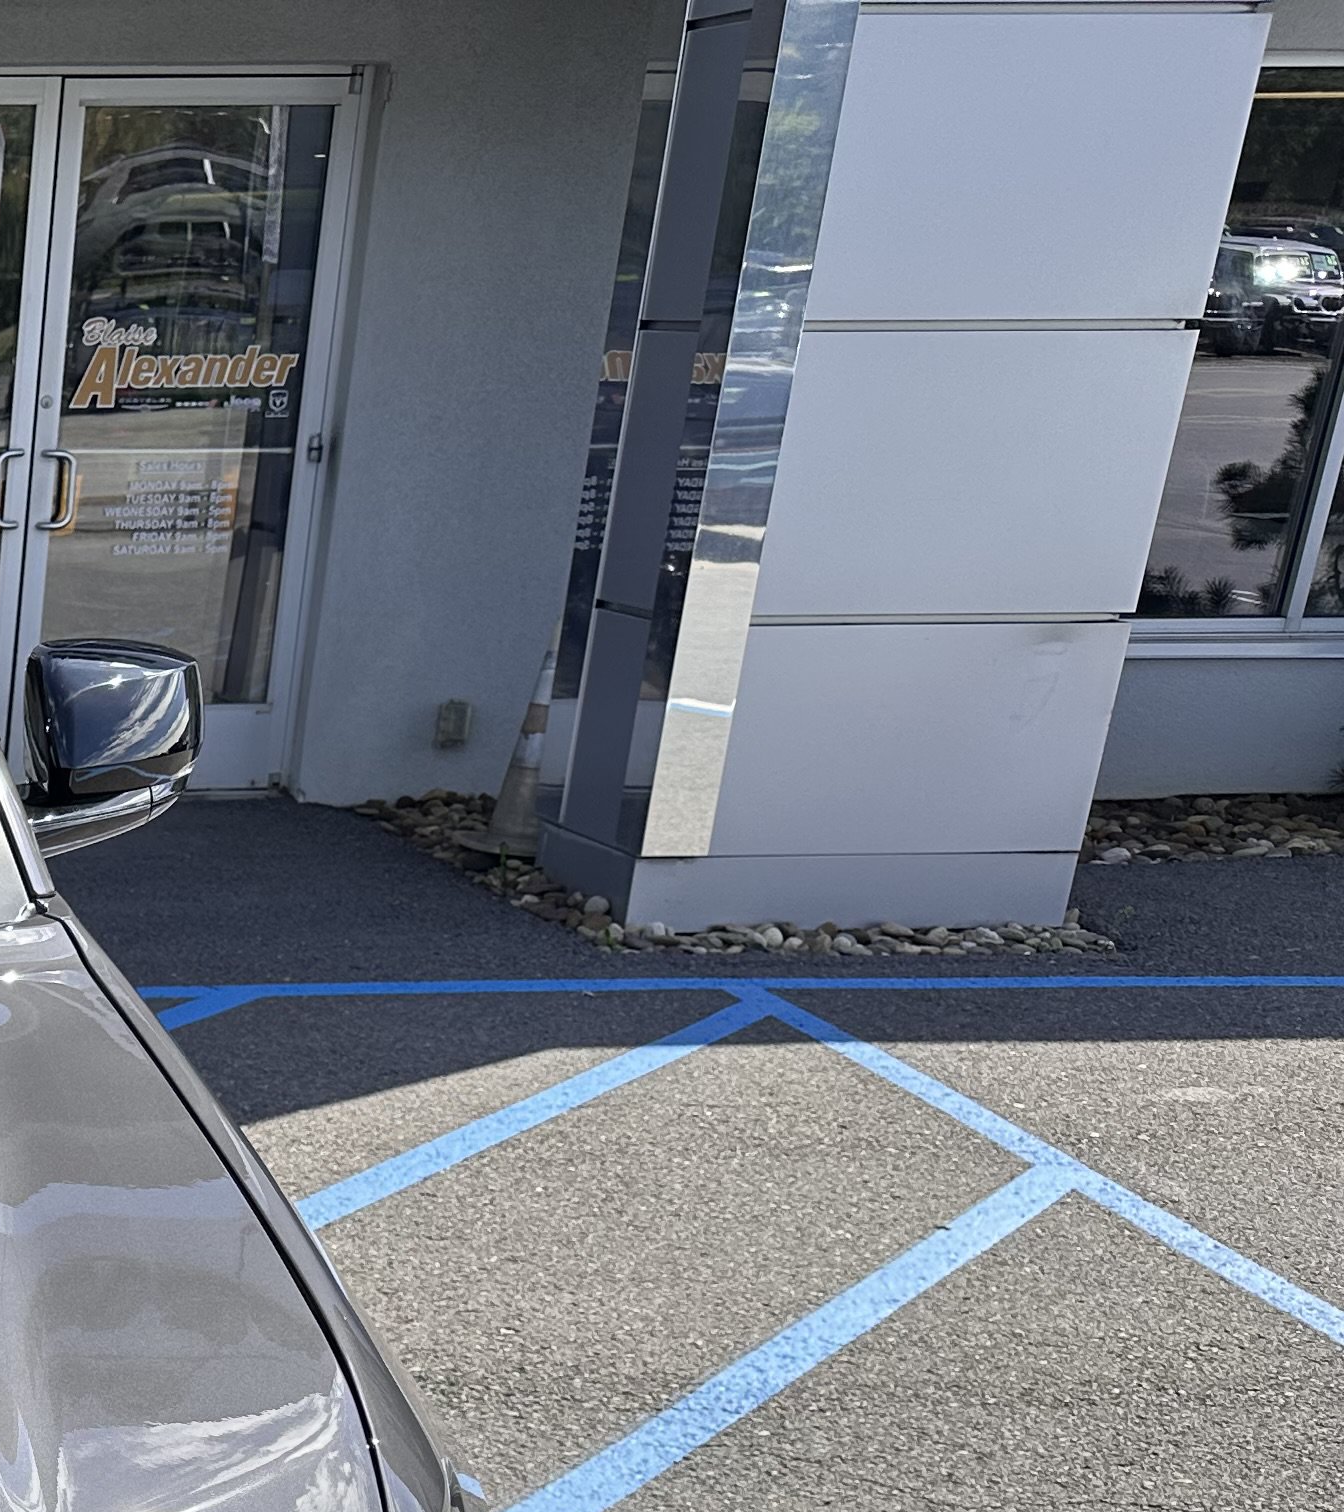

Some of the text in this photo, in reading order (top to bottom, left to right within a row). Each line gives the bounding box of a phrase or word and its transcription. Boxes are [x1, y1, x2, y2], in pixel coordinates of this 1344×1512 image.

[82, 316, 158, 346] Blaise
[69, 345, 299, 409] Alexander
[129, 481, 177, 491] MONDAY
[125, 493, 176, 504] TUESDAY
[104, 506, 174, 517] WEDNESDAY
[115, 519, 173, 530] THURSDAY
[132, 532, 172, 542] FRIDAY
[112, 544, 171, 555] SATURDAY
